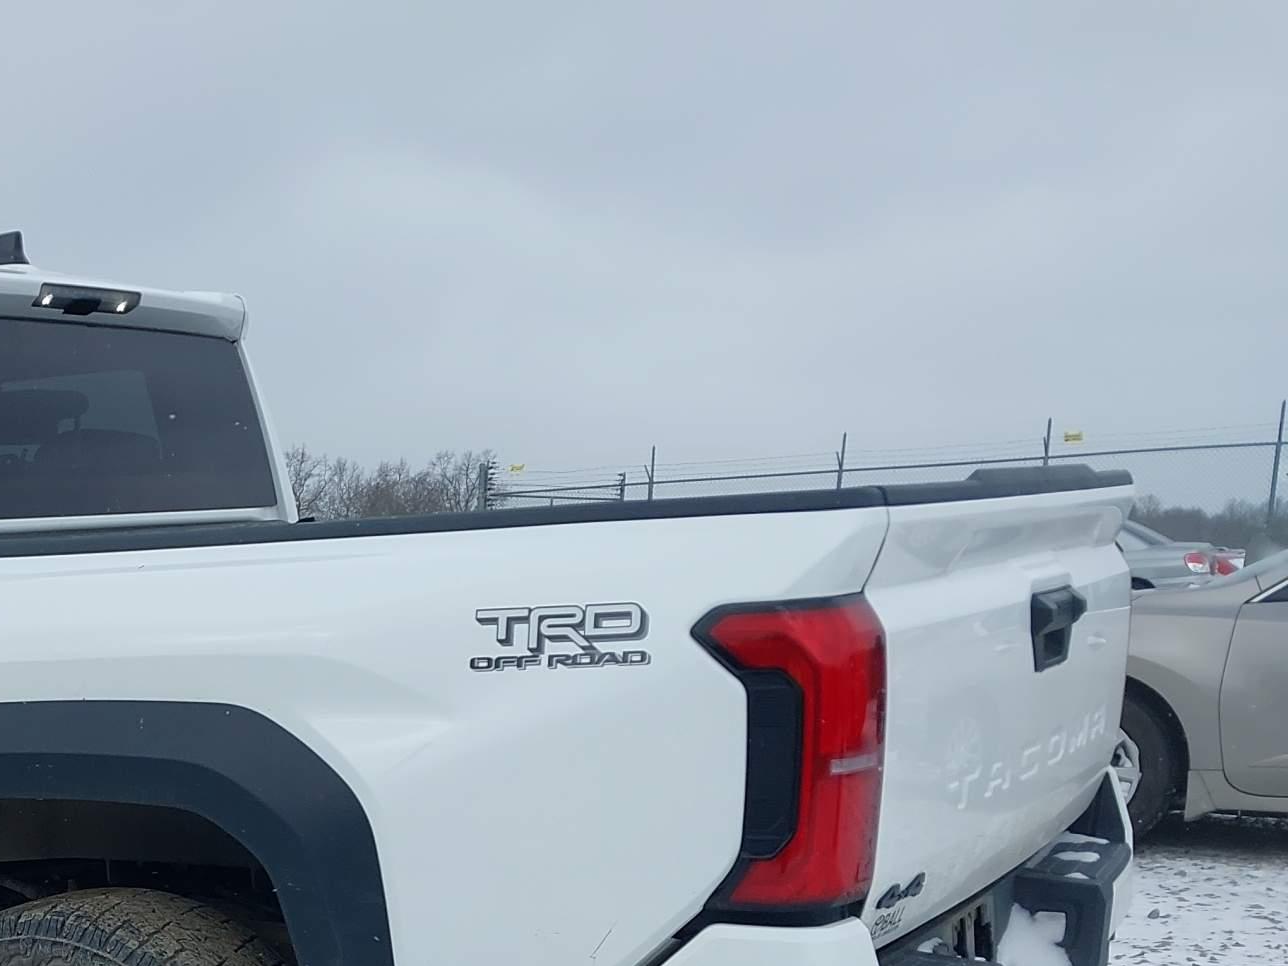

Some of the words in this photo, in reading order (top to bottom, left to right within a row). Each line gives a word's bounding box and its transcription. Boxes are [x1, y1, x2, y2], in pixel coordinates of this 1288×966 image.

[475, 602, 649, 653] TRD
[469, 655, 541, 671] OFF
[547, 650, 651, 669] ROAD
[948, 705, 1106, 809] TACOMA
